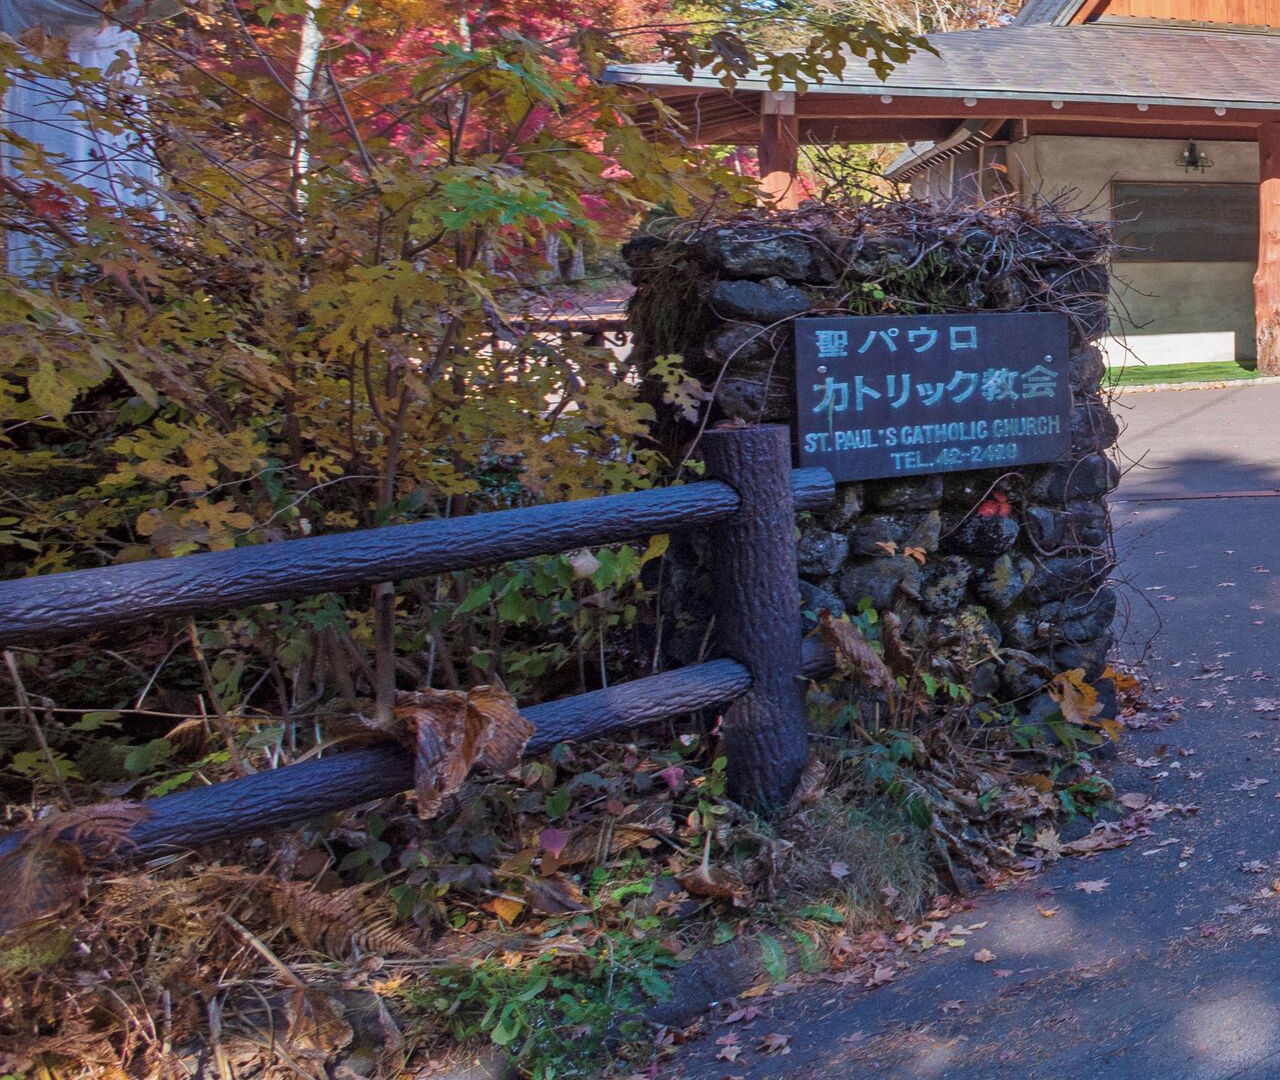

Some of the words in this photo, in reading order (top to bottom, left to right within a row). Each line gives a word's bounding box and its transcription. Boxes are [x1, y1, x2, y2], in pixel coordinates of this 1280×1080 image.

[815, 326, 978, 358] 聖パウロ
[813, 365, 1059, 412] カトリック教会
[900, 420, 988, 446] CATHOLIC
[993, 415, 1061, 438] CHURCH
